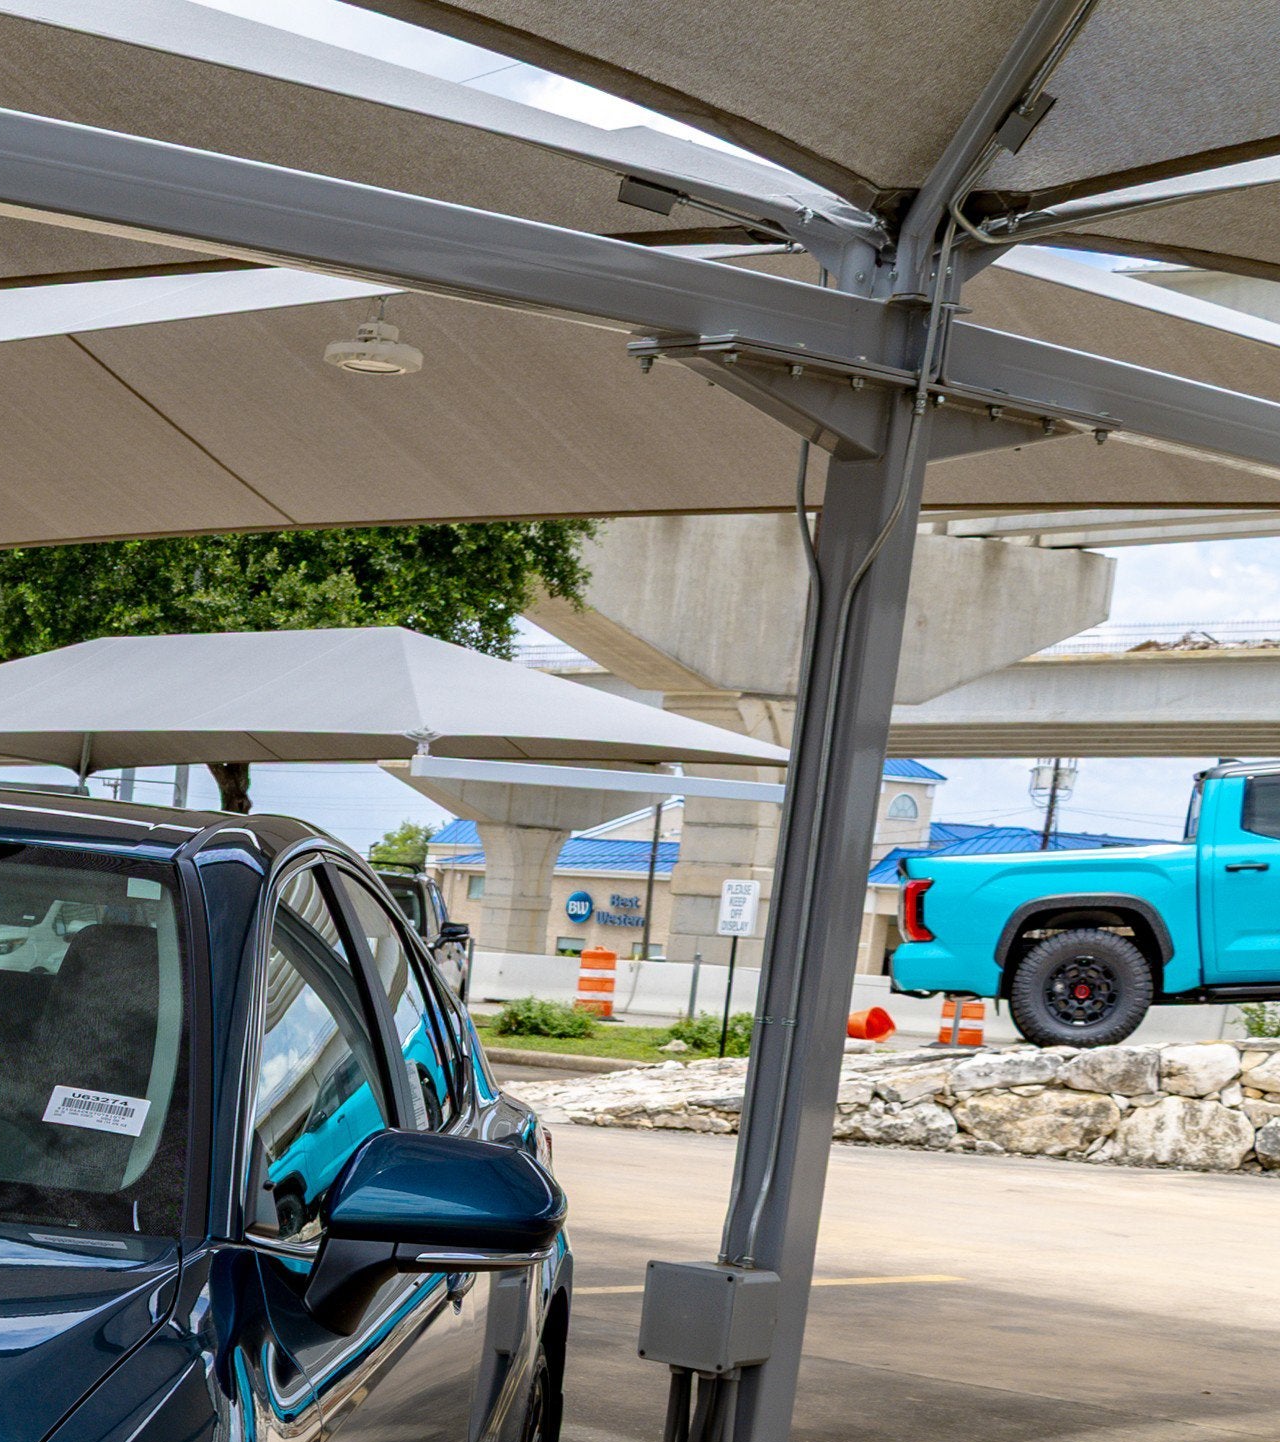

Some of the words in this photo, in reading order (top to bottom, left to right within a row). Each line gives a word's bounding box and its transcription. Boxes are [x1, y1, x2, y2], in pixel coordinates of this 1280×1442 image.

[727, 884, 752, 895] PLEASE
[610, 894, 641, 909] Best
[729, 896, 746, 907] KEEP
[568, 900, 590, 915] BW
[730, 908, 743, 919] OFF
[595, 911, 645, 928] Western
[721, 920, 749, 931] DISPLAY
